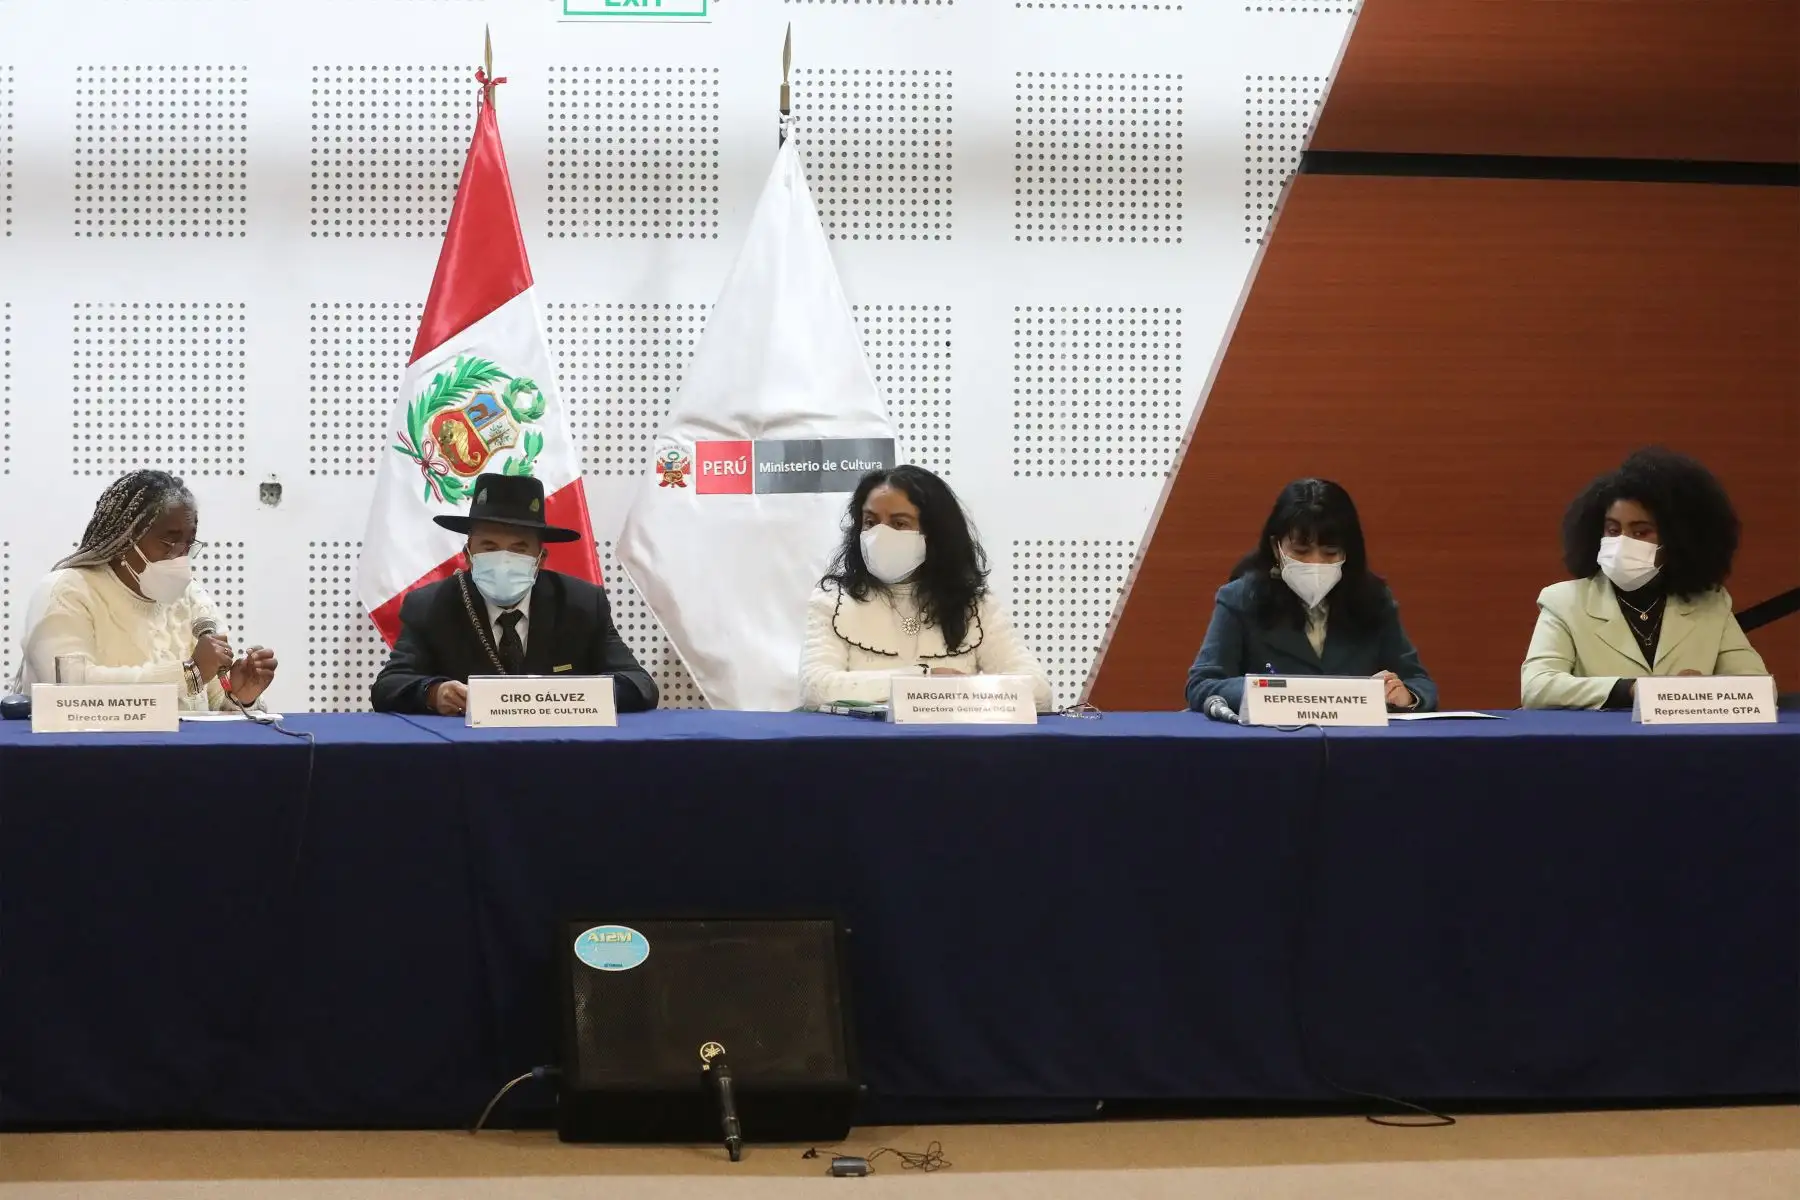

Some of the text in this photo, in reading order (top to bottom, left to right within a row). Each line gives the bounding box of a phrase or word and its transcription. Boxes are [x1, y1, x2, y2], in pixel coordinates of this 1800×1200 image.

[703, 456, 747, 475] PERÚ
[759, 459, 883, 473] Ministerio de Cultura
[500, 691, 585, 703] CIRO GÁLVEZ
[906, 692, 970, 700] MARGARITA
[1264, 694, 1368, 705] REPRESENTANTE
[1657, 692, 1754, 701] MEDALINE PALMA
[56, 698, 157, 708] SUSANA MATUTE
[490, 708, 537, 716] MINISTRO
[554, 707, 599, 715] CULTURA
[912, 705, 954, 713] Directora
[1654, 706, 1761, 716] Representante GTPA
[123, 713, 147, 721] DAF
[1297, 710, 1338, 720] MINAM
